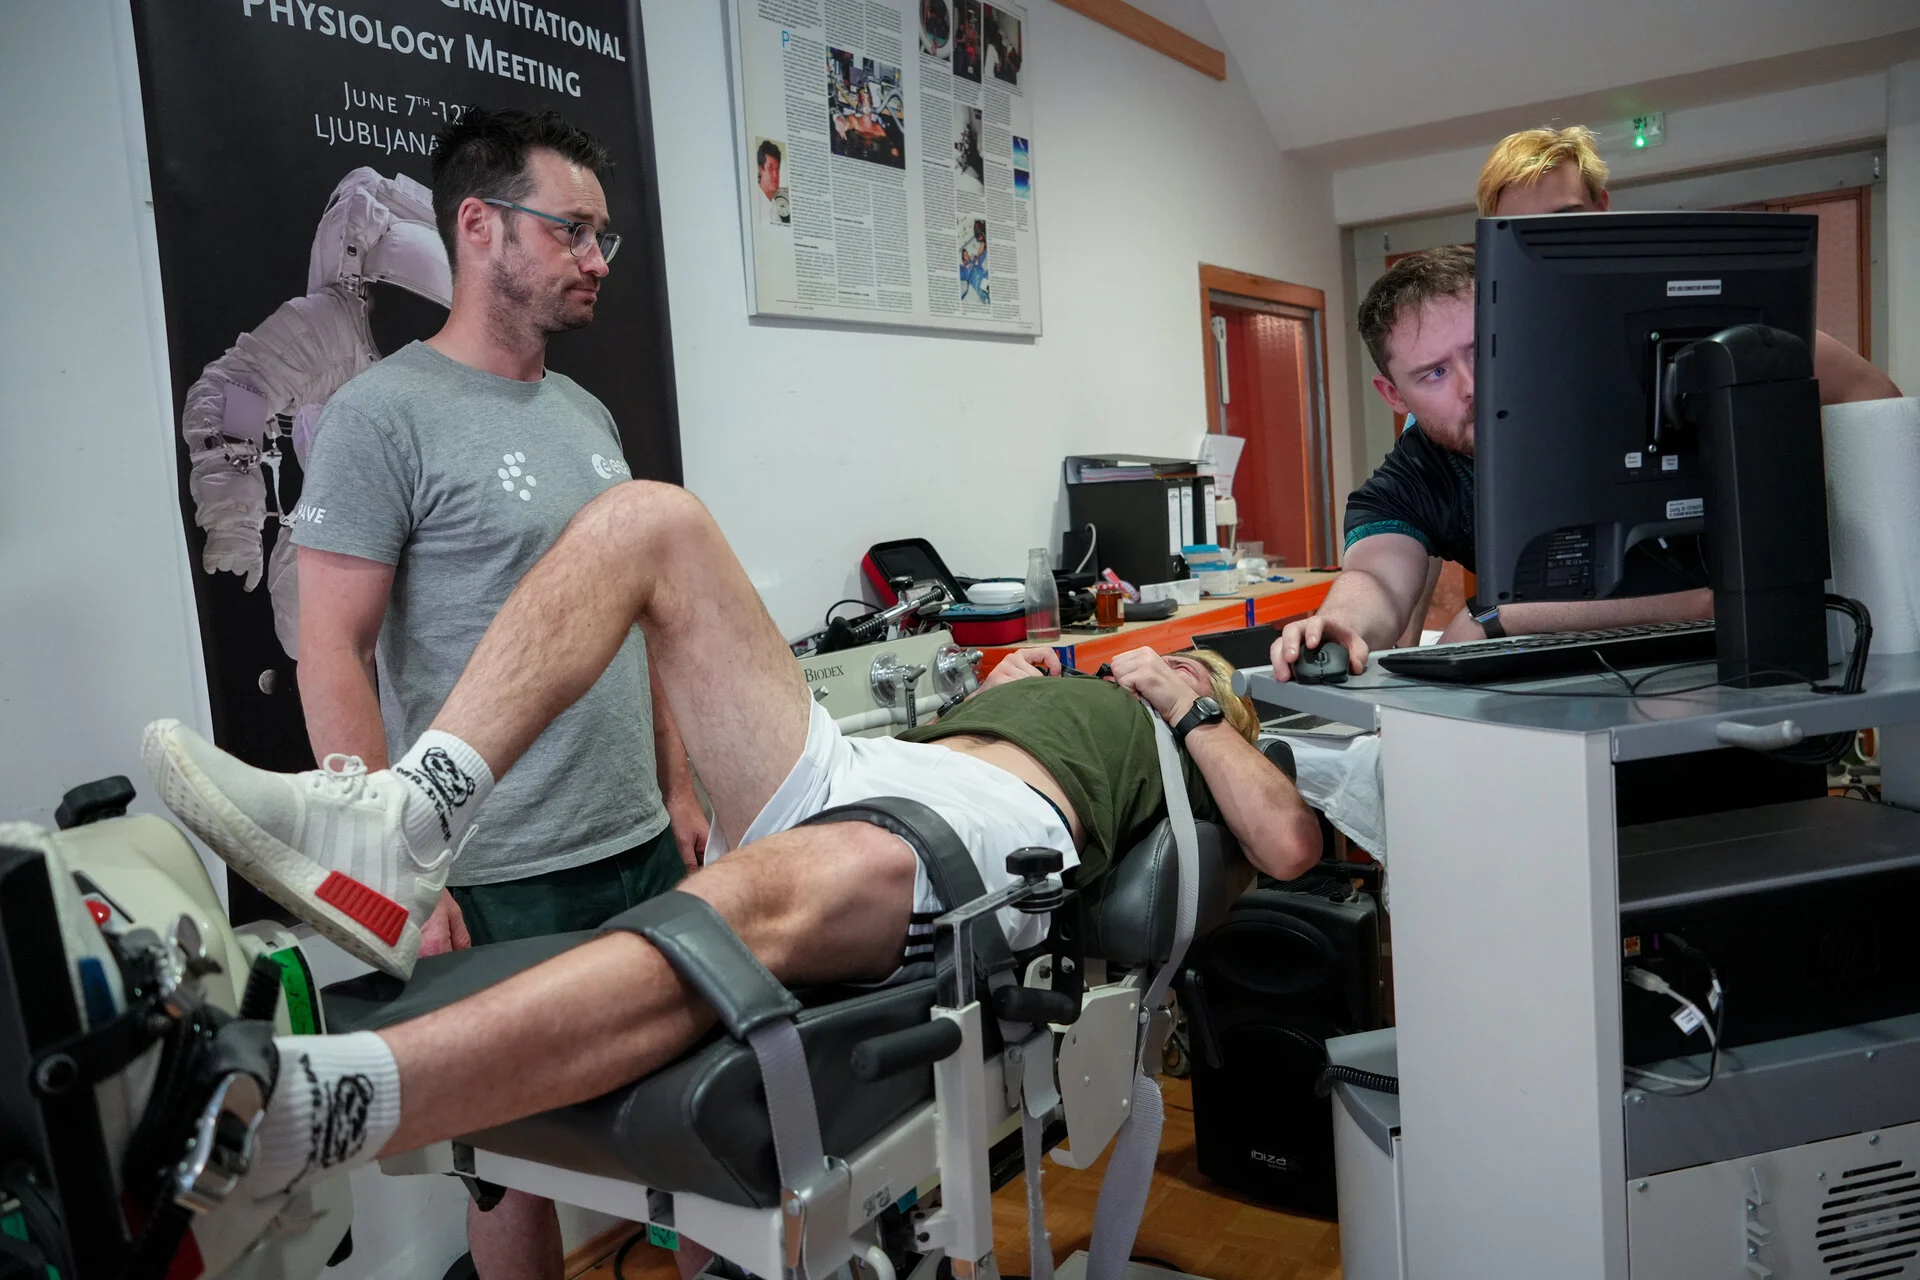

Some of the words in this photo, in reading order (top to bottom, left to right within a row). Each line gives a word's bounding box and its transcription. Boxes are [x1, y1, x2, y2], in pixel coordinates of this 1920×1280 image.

[440, 0, 626, 62] RAVITATIONAL
[465, 34, 582, 97] MEETING
[344, 81, 398, 111] JUNE
[405, 94, 475, 125] 7TH-12T
[314, 113, 439, 156] LJUBLJANA
[804, 665, 845, 682] BIODEX
[1250, 1149, 1287, 1166] ibiza
